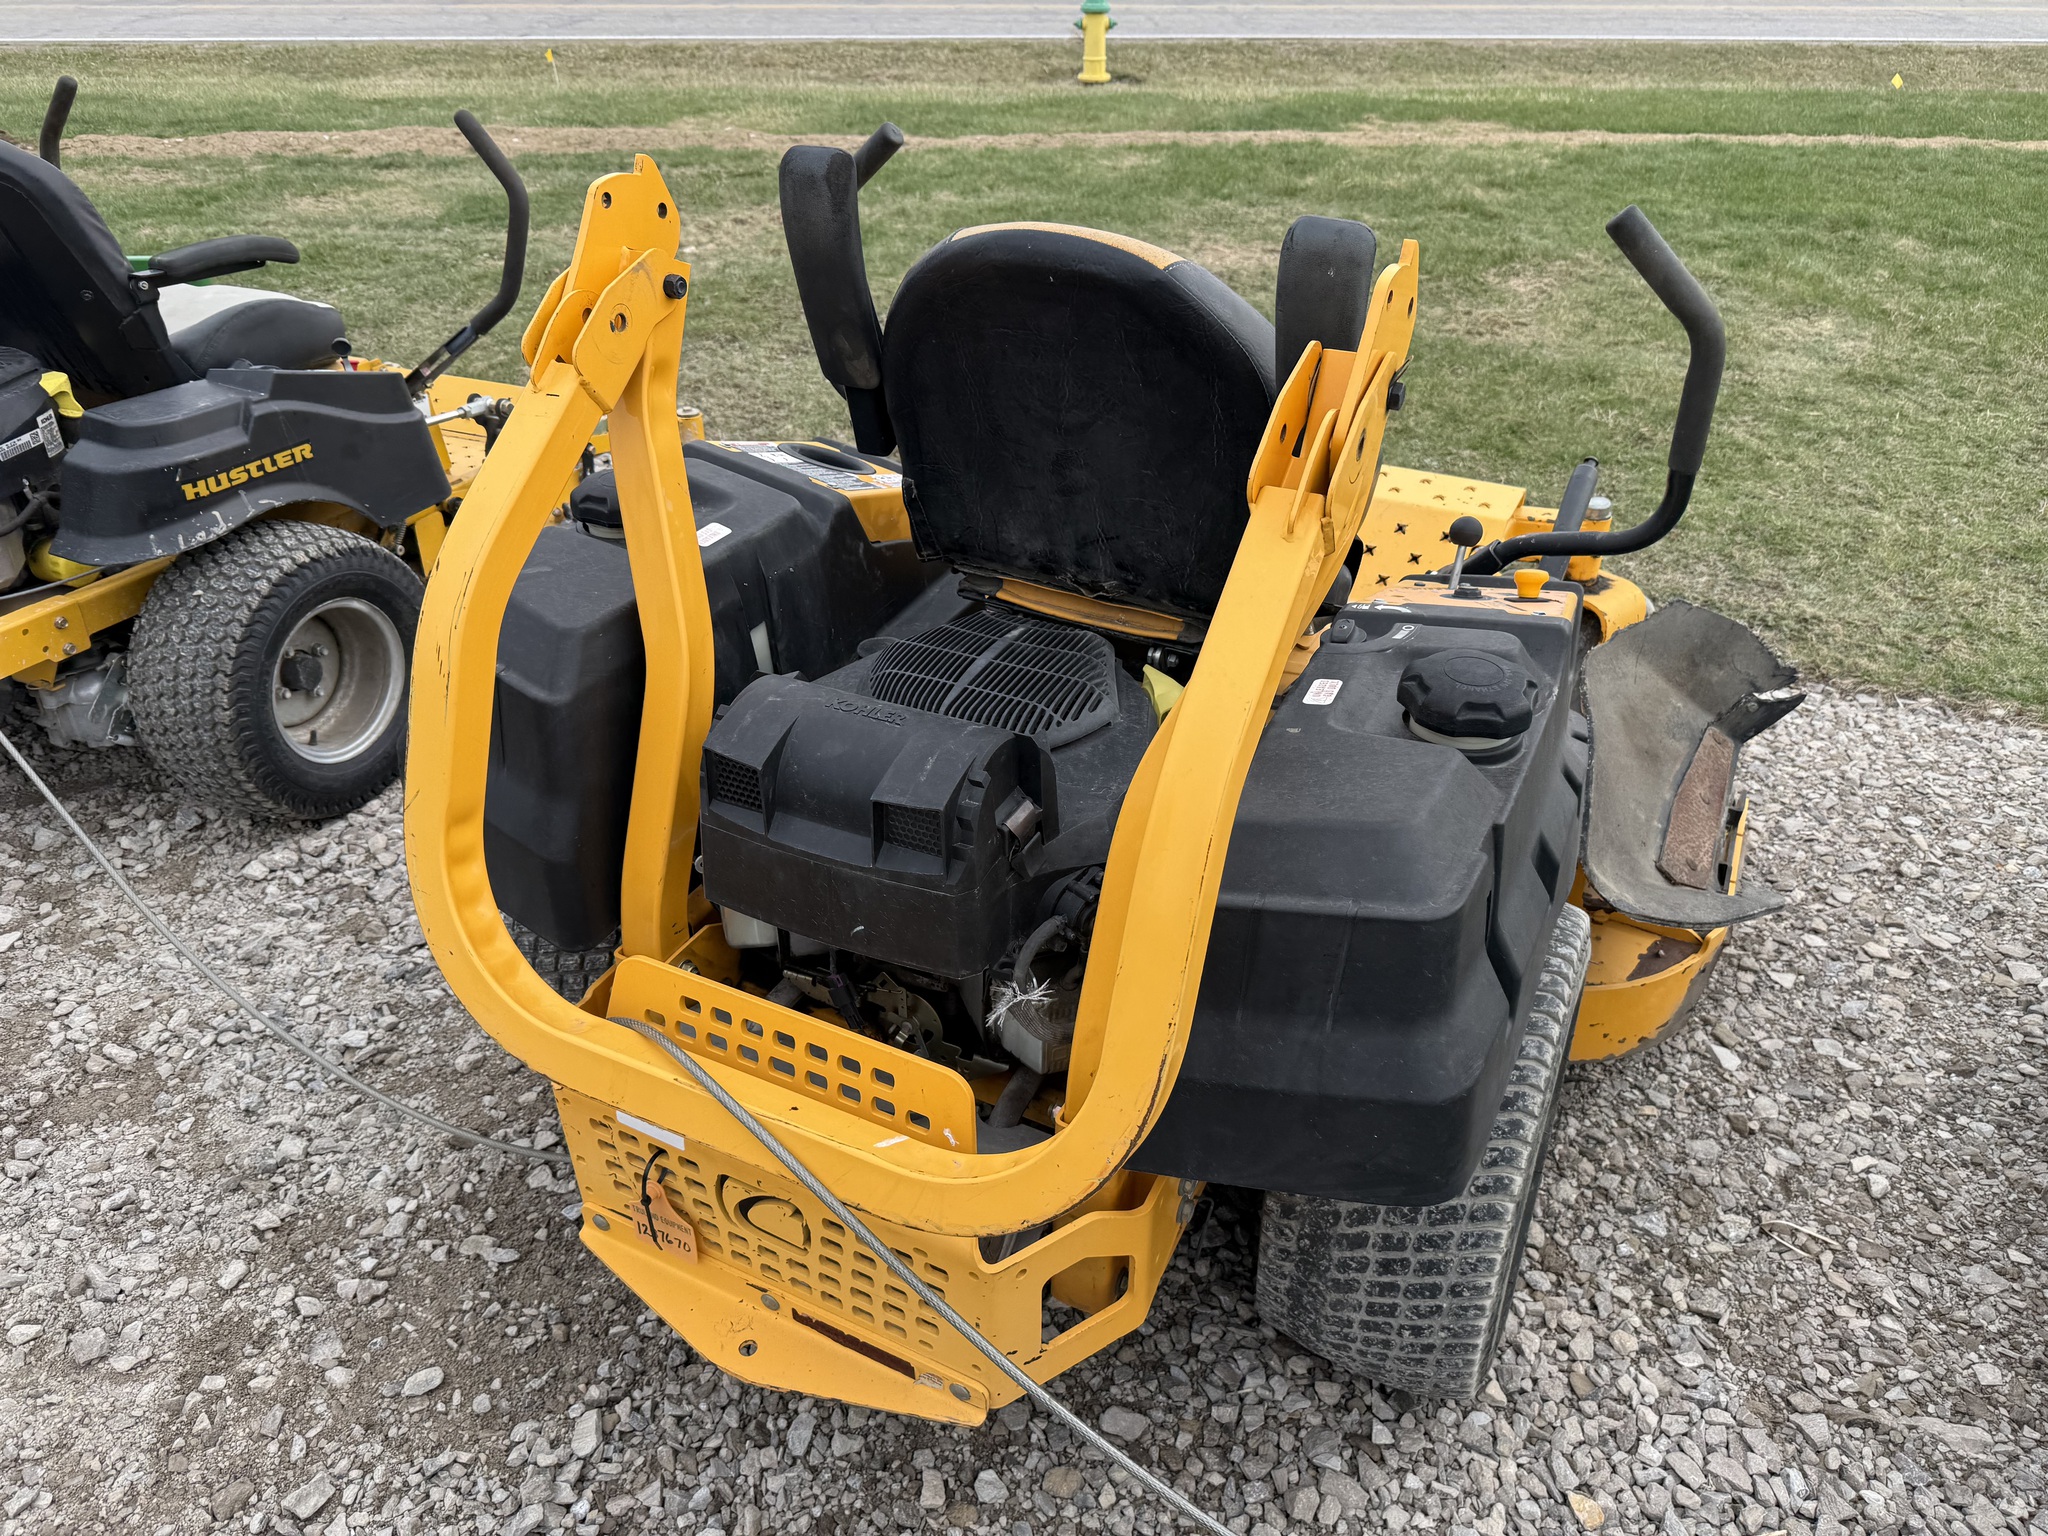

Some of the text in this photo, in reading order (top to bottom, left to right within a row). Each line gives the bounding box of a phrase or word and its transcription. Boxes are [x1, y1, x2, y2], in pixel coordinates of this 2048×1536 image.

[181, 443, 314, 501] HUSTLER
[824, 698, 907, 727] KOHLER
[636, 1220, 692, 1253] 127670
[660, 1215, 692, 1236] EQUIPMENT
